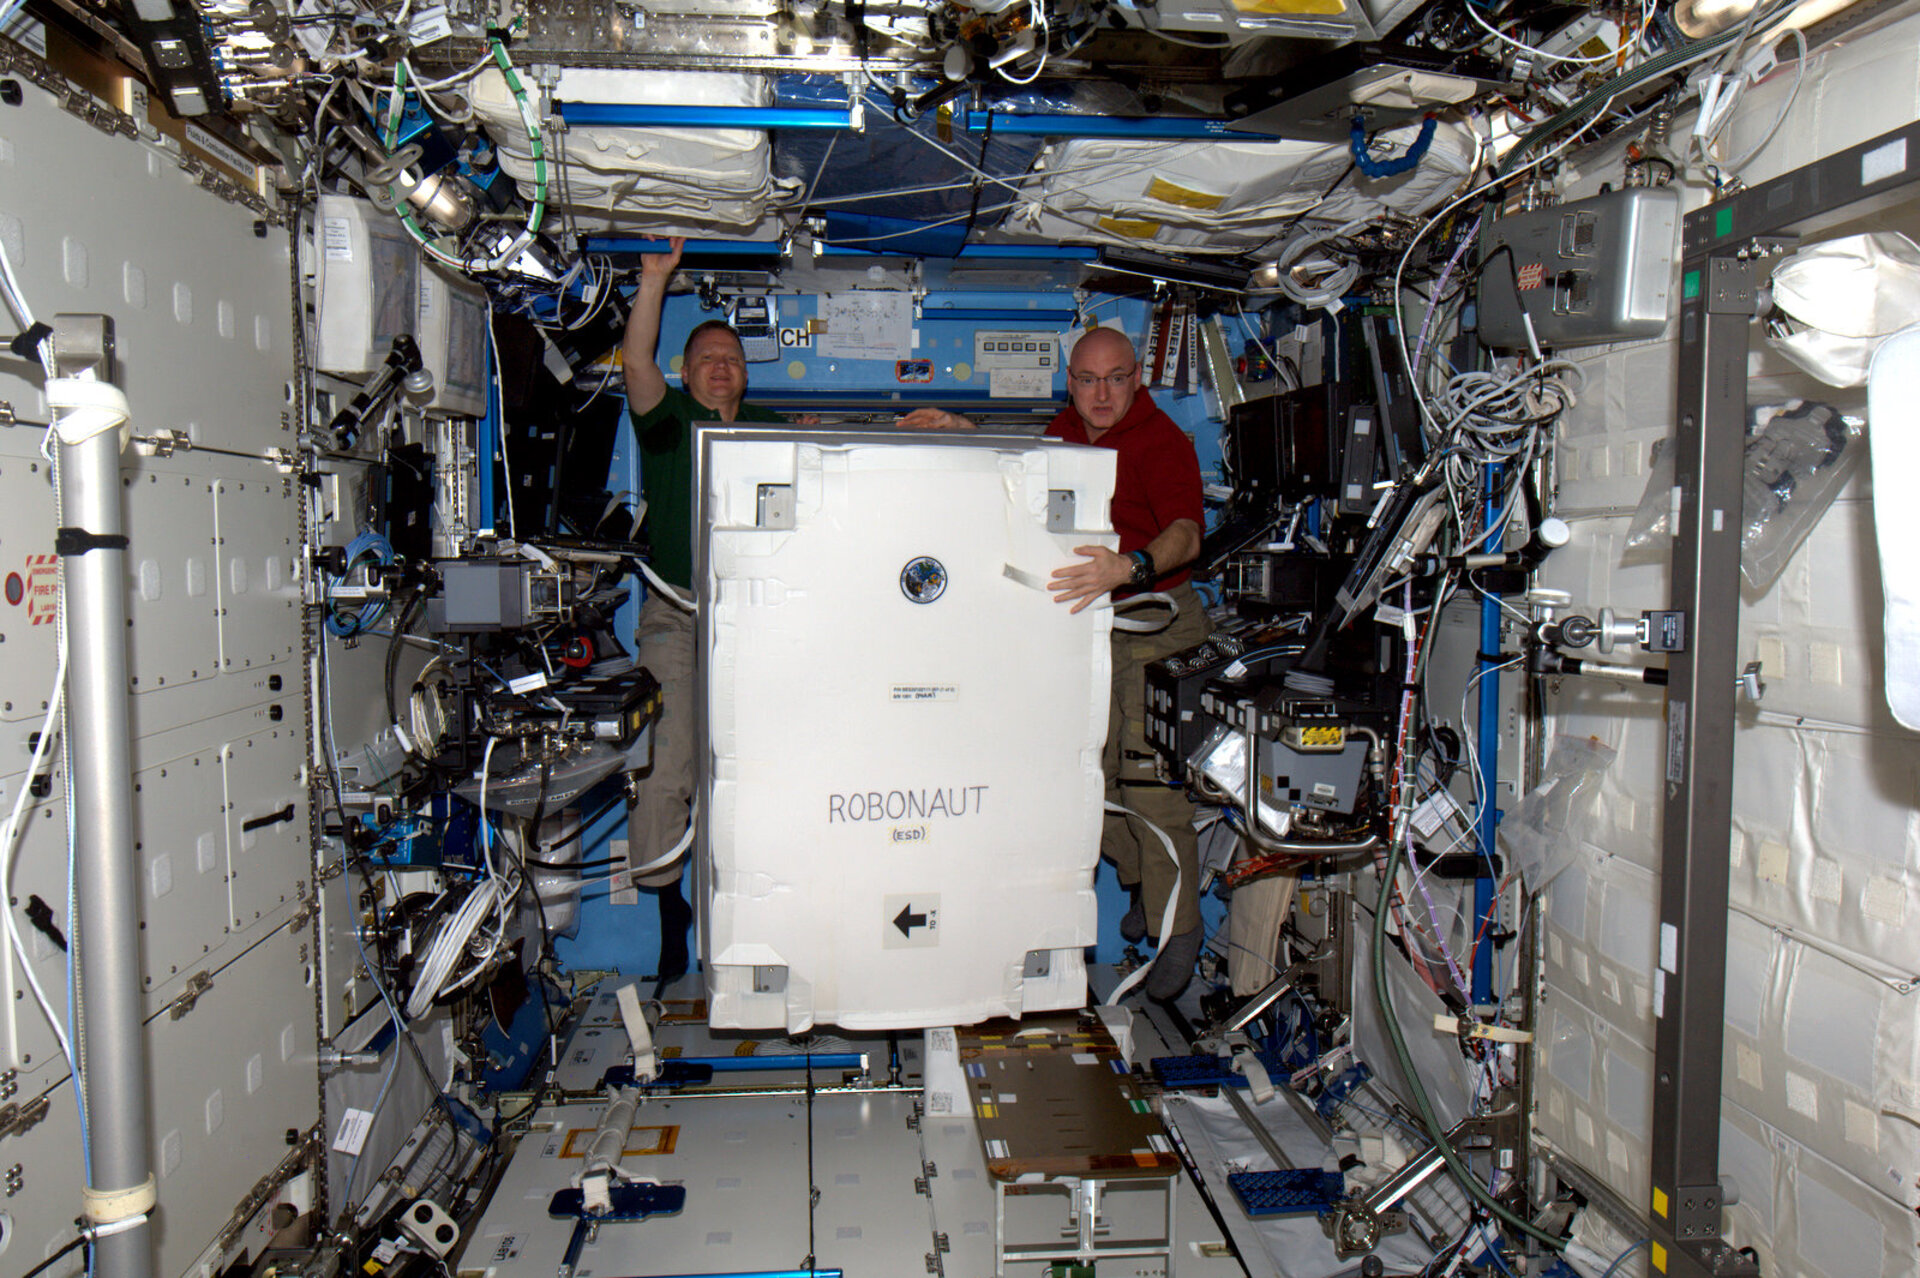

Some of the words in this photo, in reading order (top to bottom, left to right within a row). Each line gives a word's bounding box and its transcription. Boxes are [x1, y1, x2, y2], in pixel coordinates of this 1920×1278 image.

[1147, 312, 1161, 356] EMER
[1167, 314, 1182, 356] EMER
[1189, 315, 1197, 369] WARNING
[1166, 360, 1175, 370] 2
[34, 585, 50, 595] FIRE
[829, 786, 989, 824] ROBONAUT
[892, 826, 926, 842] (ESD)
